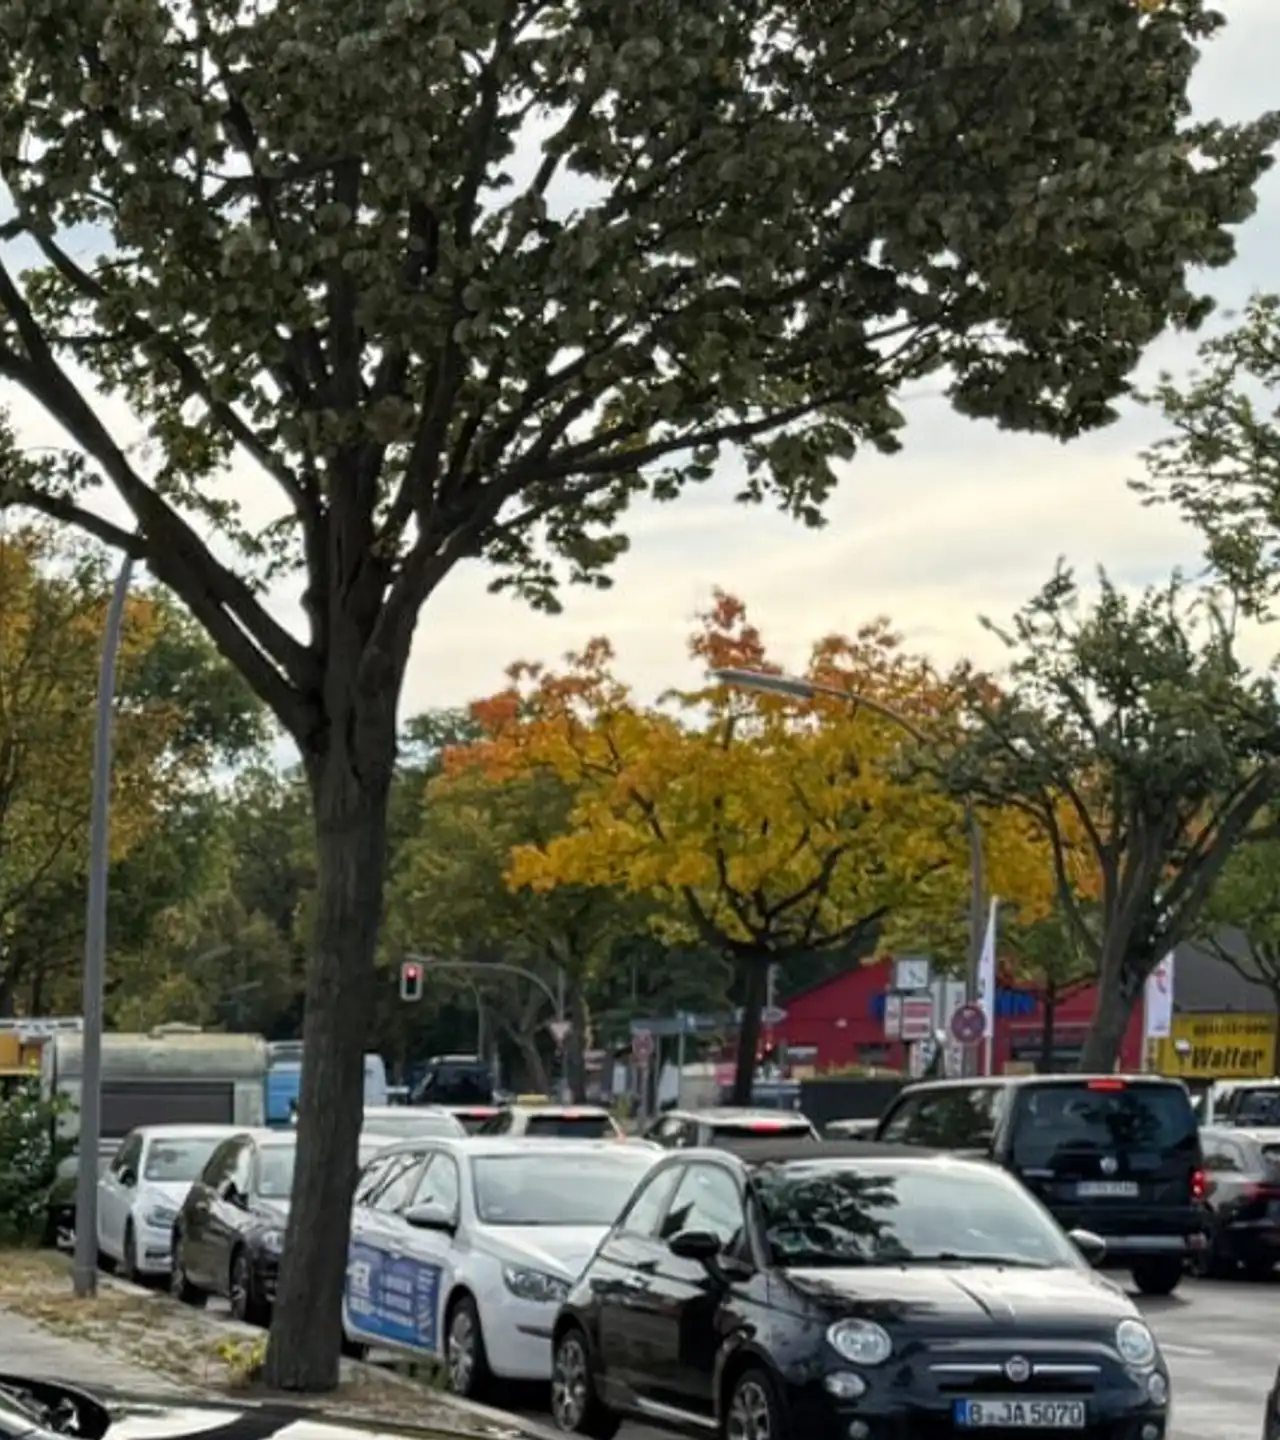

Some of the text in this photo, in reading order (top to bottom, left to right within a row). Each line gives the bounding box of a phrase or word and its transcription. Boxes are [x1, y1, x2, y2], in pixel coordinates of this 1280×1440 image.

[968, 1402, 1083, 1425] B JA 5070
